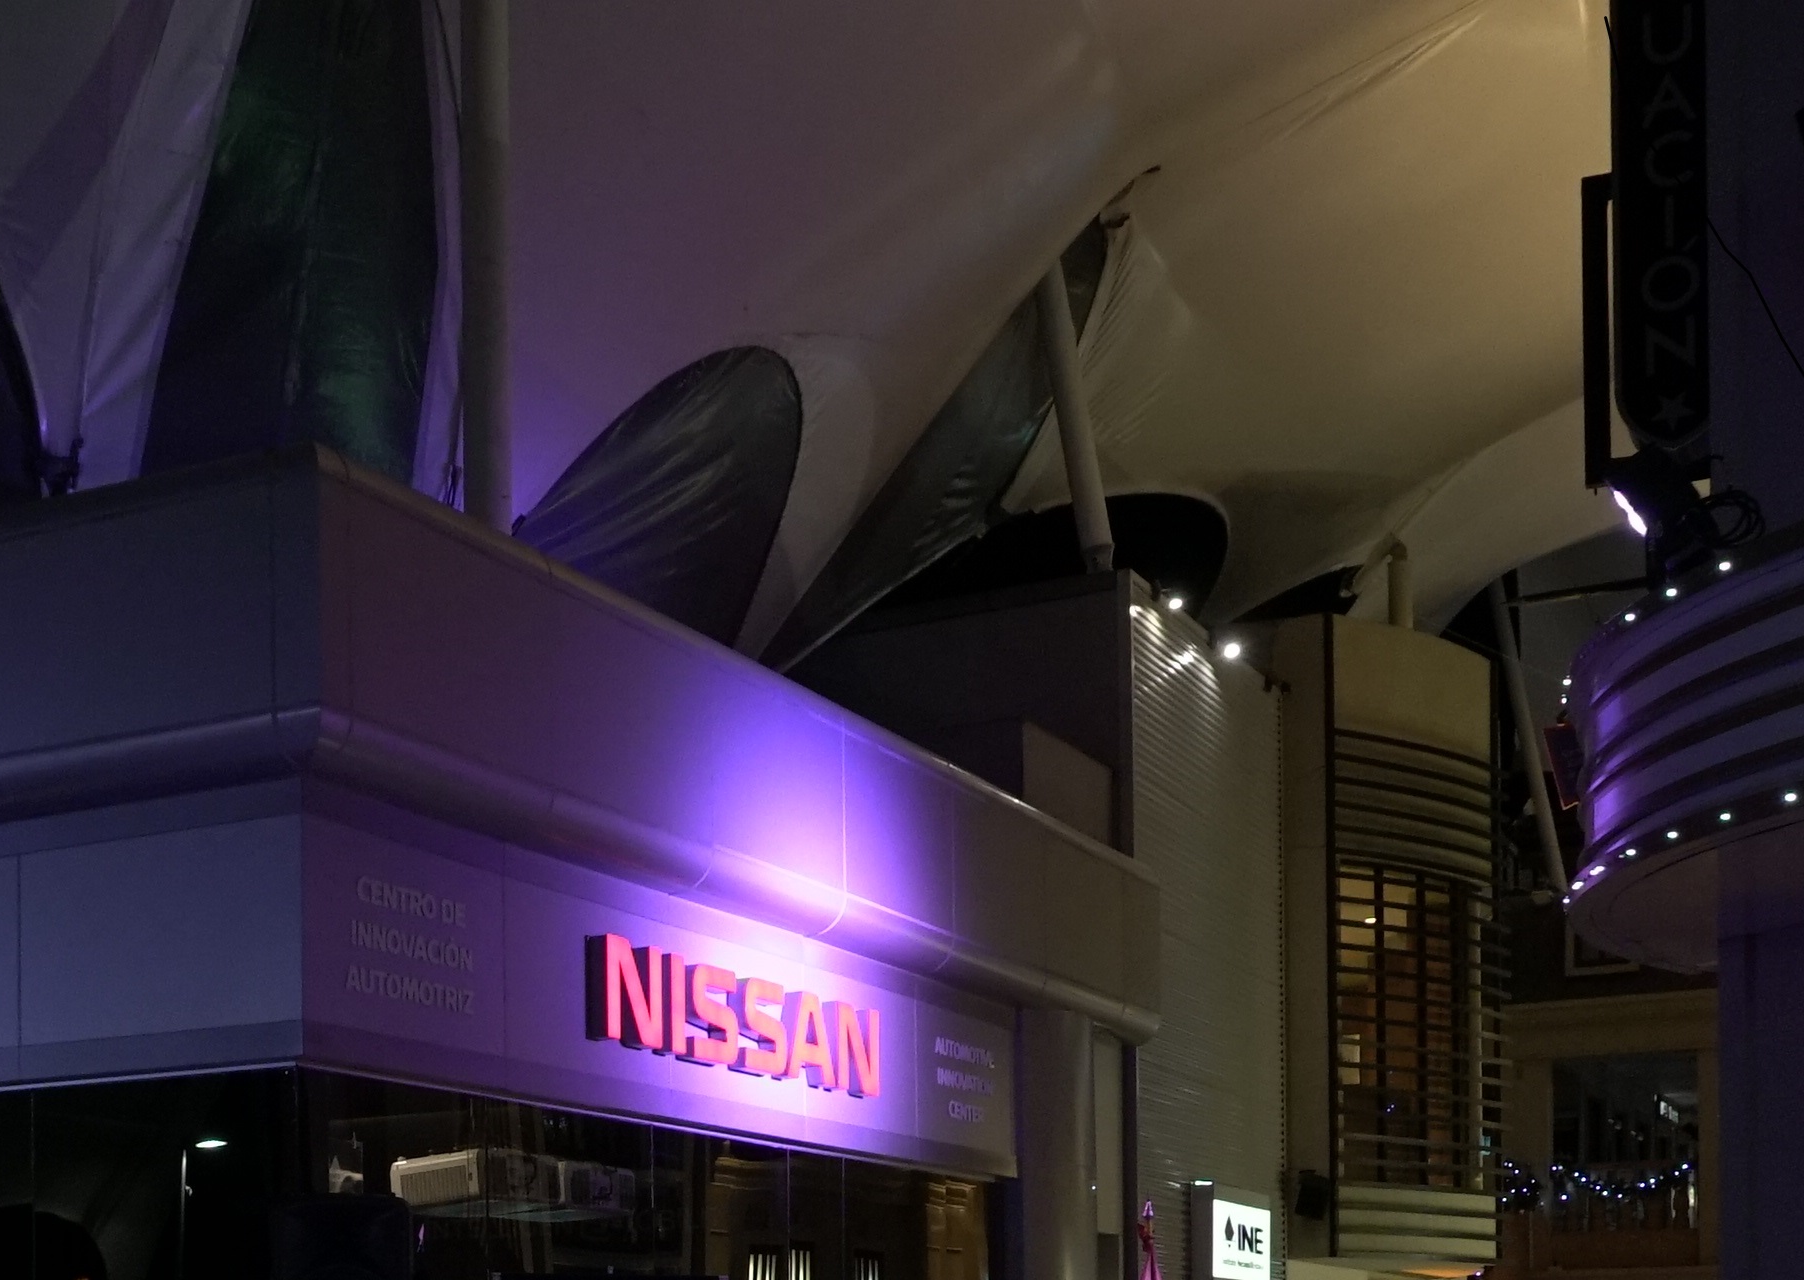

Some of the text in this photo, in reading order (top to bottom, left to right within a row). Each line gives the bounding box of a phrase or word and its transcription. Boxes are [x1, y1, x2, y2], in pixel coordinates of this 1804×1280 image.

[356, 876, 467, 928] CENTRO DE
[350, 920, 473, 972] INNOVACIÓN
[346, 965, 475, 1014] AUTOMOTRIZ
[585, 933, 880, 1098] NISSAN
[1238, 1223, 1263, 1255] INE
